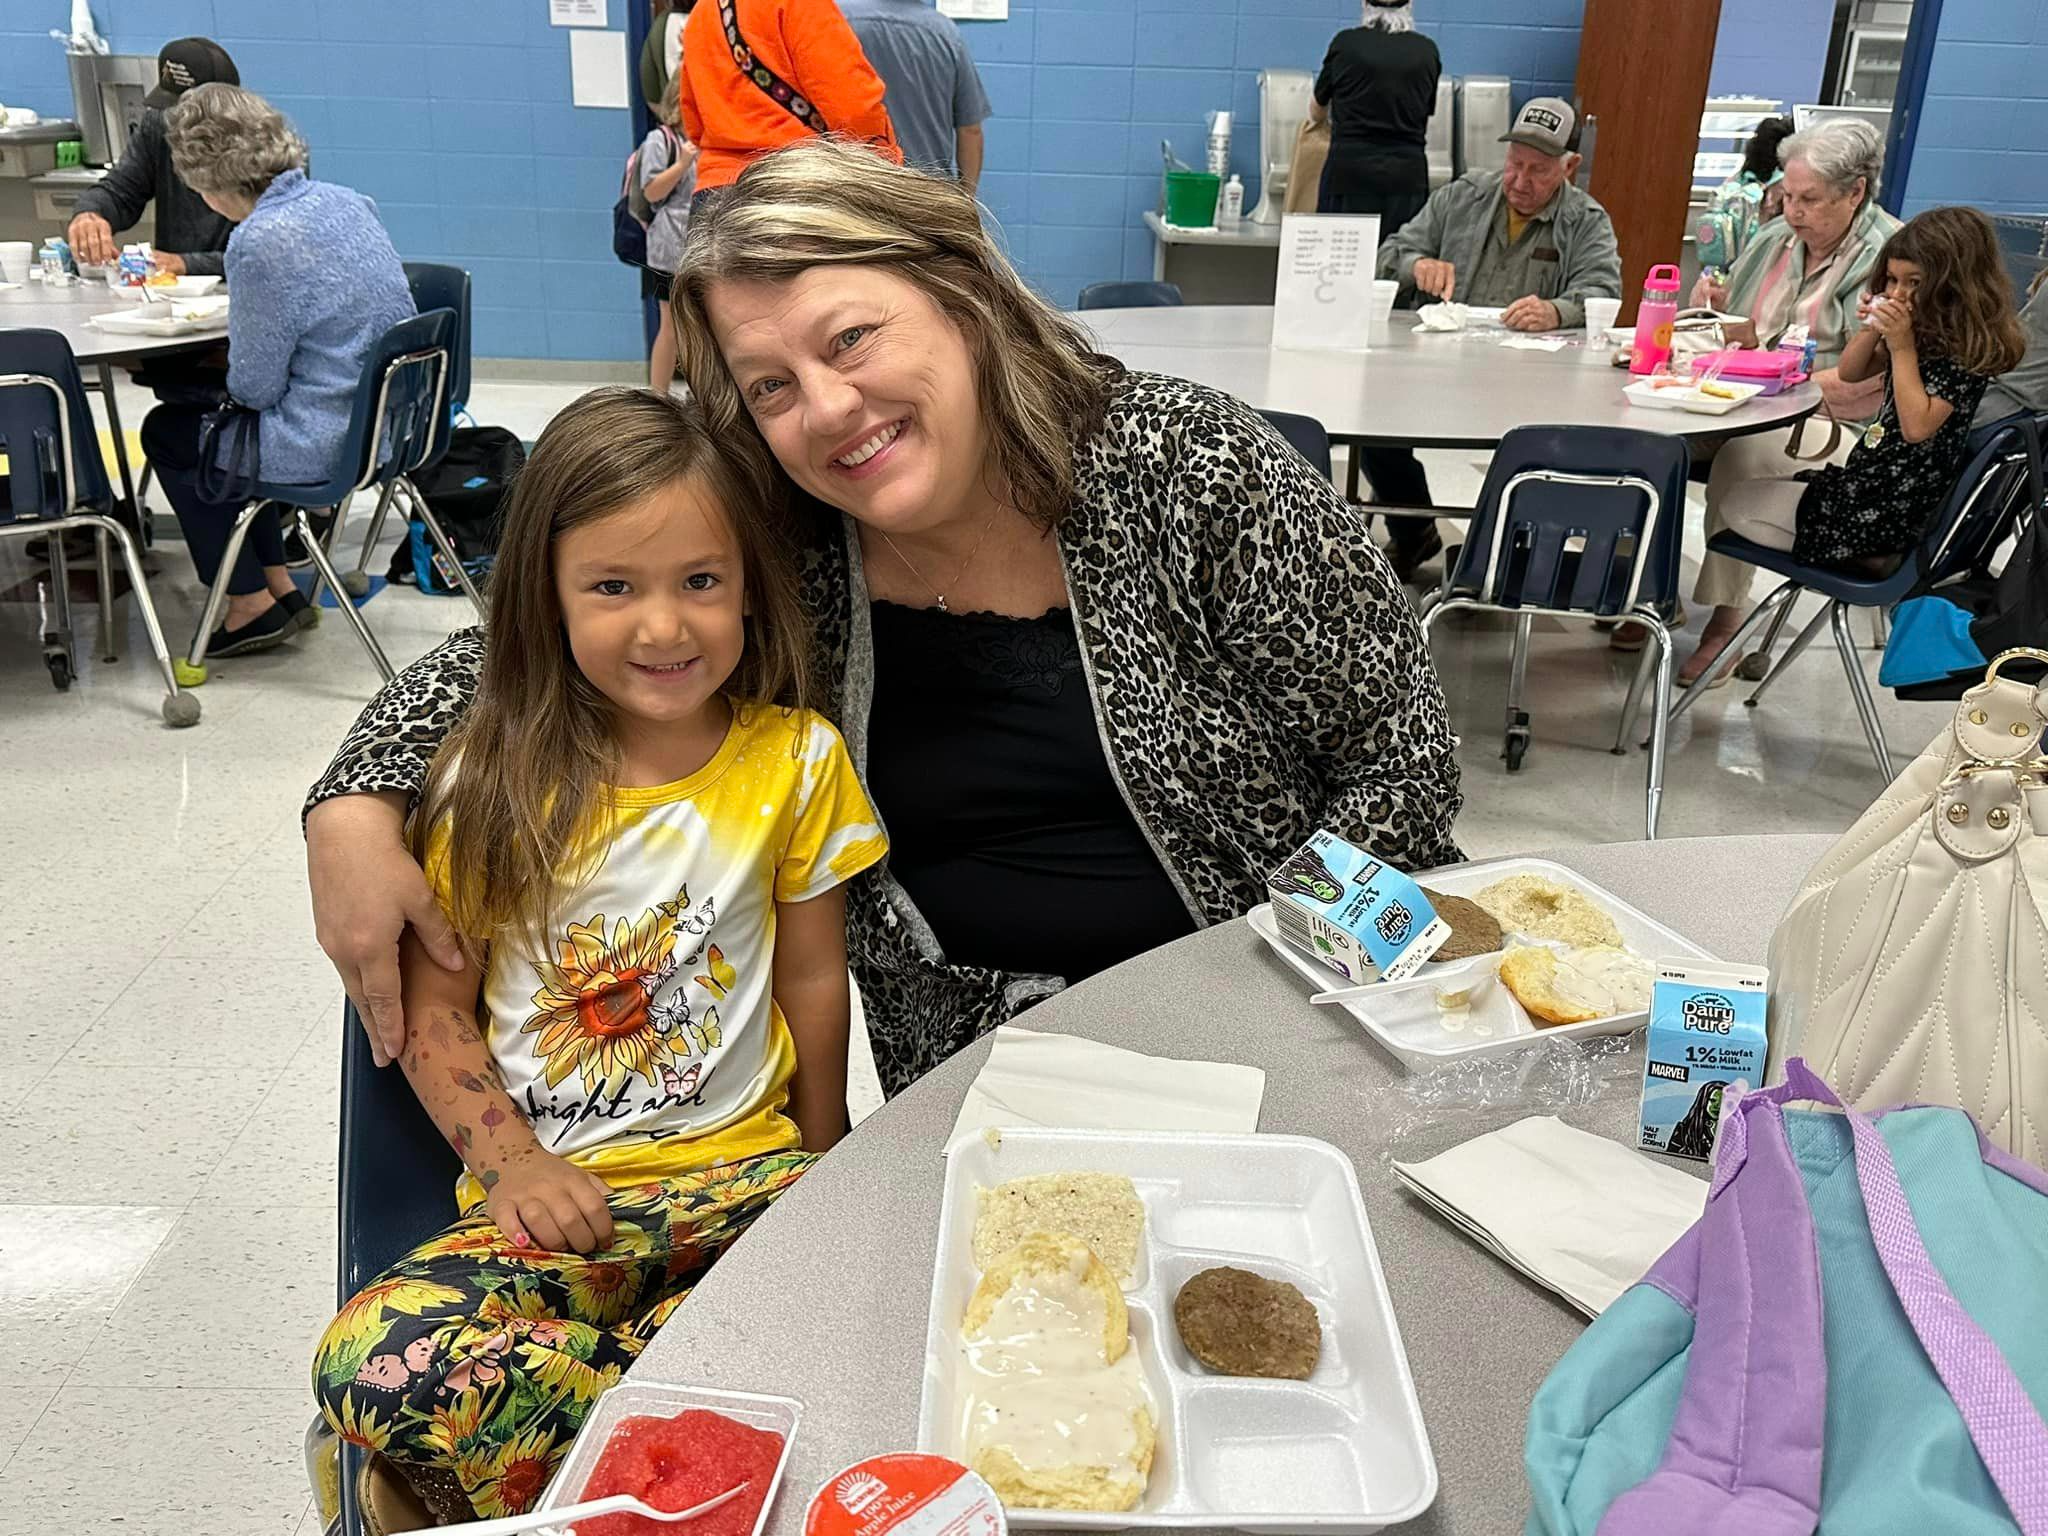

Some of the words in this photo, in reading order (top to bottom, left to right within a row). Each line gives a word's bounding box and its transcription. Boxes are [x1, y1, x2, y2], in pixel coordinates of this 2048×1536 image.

[1357, 886, 1380, 908] 1%
[1375, 898, 1403, 929] Pure
[1381, 909, 1413, 941] Dairy
[1682, 1000, 1735, 1025] Dairy
[1685, 1013, 1731, 1034] Pure
[1685, 1046, 1718, 1063] 1%
[1719, 1048, 1754, 1058] Lowfat
[1719, 1056, 1741, 1065] Milk
[1651, 1063, 1686, 1080] MARVEL
[641, 1066, 716, 1114] and
[1643, 1125, 1659, 1133] HALF
[854, 1509, 889, 1536] Apple
[887, 1492, 917, 1514] Juice
[860, 1494, 892, 1520] 100%
